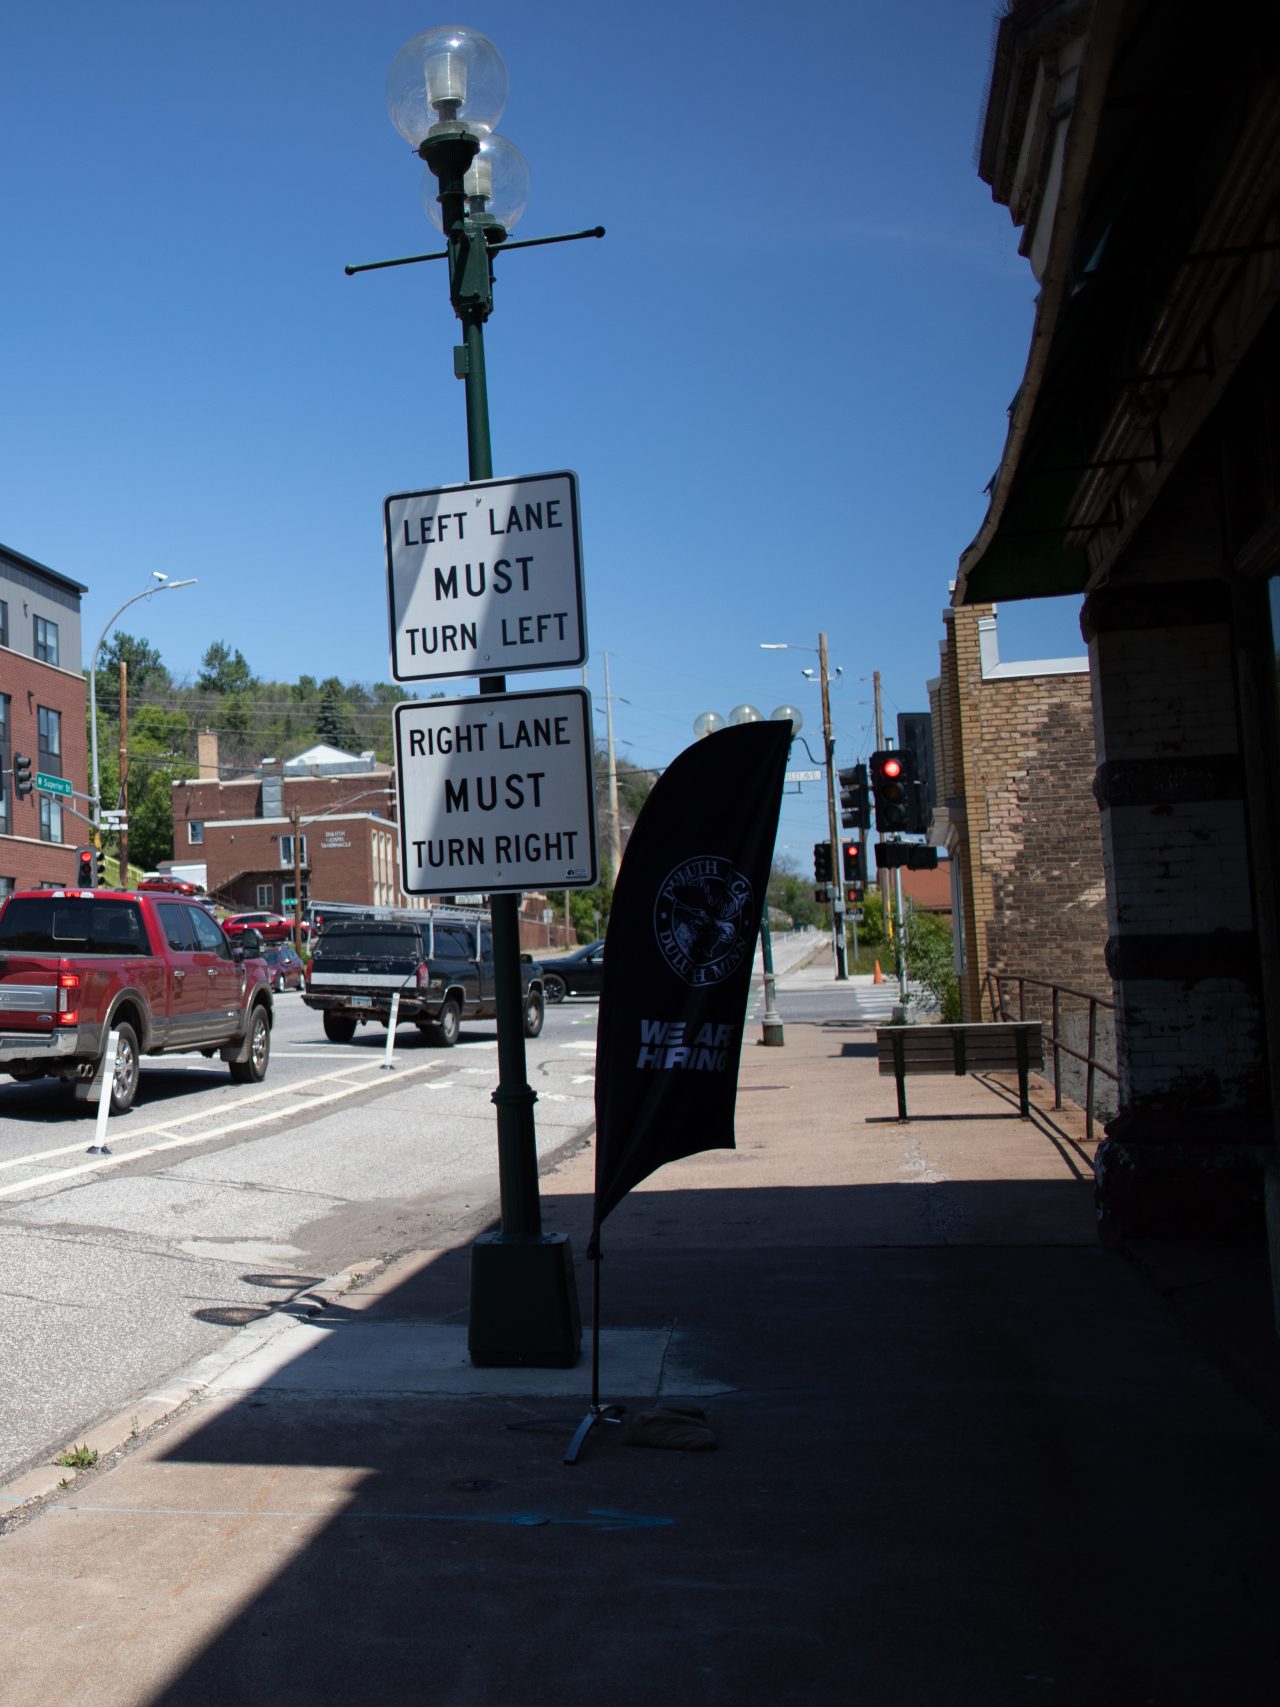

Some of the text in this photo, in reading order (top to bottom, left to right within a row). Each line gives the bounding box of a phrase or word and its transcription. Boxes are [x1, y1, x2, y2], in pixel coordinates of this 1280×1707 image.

[403, 500, 563, 546] LEFT LANE
[433, 556, 534, 601] MUST
[405, 612, 568, 656] TURN LEFT
[409, 716, 571, 757] RIGHT LANE
[44, 778, 64, 791] Superior
[444, 772, 546, 814] MUST
[412, 831, 578, 868] TURN RIGHT
[641, 1019, 687, 1045] WE
